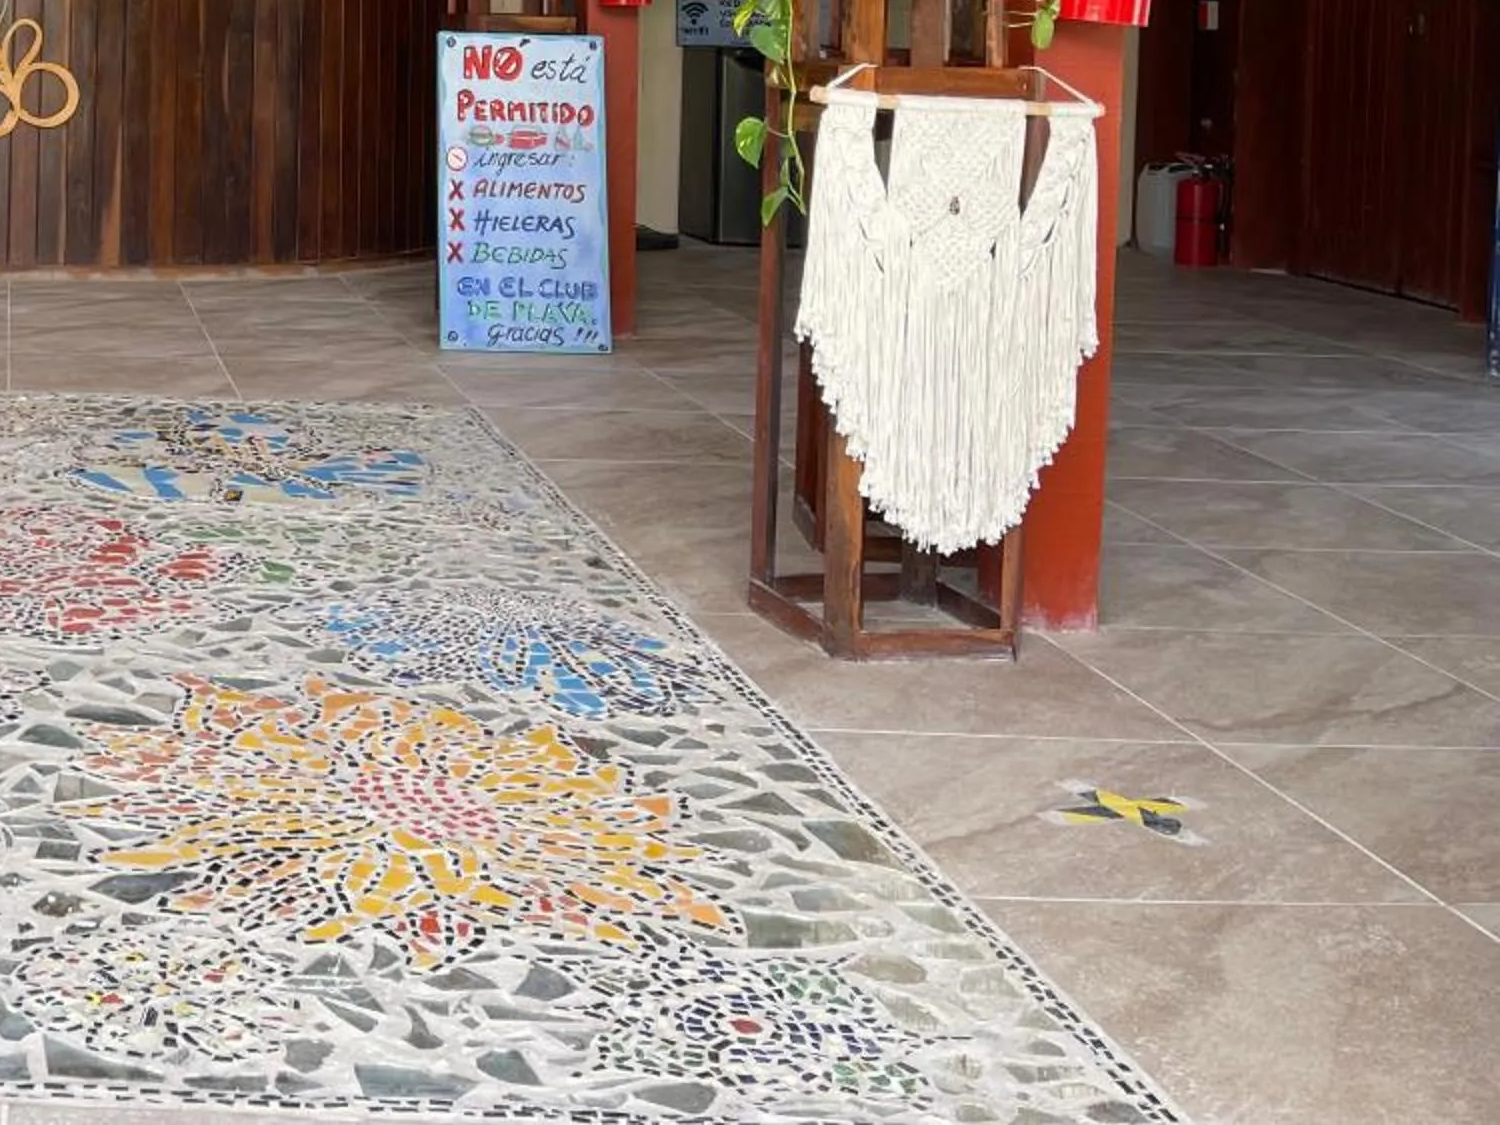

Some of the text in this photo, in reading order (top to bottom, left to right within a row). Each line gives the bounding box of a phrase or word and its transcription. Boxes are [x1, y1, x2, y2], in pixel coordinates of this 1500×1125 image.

[531, 53, 591, 84] está
[472, 178, 587, 204] ALIMENTOS
[473, 208, 576, 240] HIELERAS
[470, 241, 568, 270] BEBIDAS
[457, 276, 599, 302] EN EL CLUB
[466, 298, 501, 320] DE
